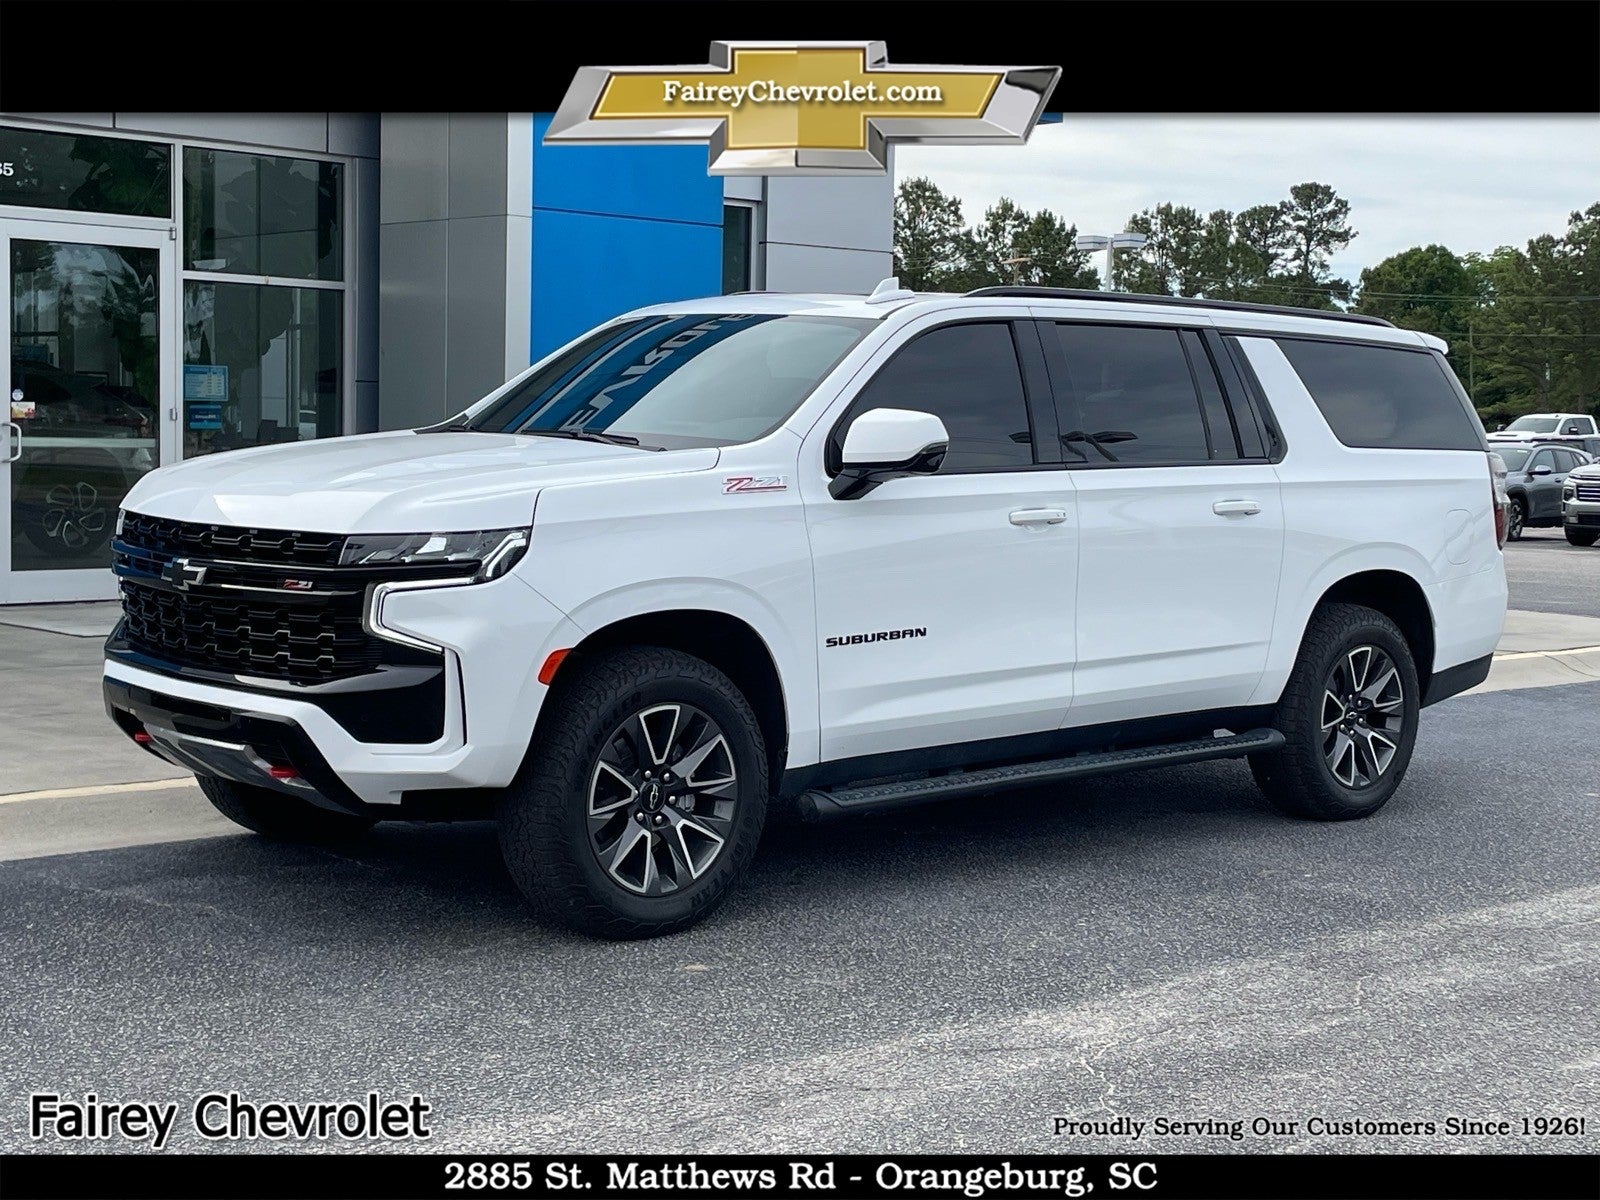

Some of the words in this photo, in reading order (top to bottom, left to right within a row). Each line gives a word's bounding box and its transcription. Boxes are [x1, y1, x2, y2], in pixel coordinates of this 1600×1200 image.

[0, 162, 14, 177] 5
[722, 476, 787, 495] Z71
[825, 627, 927, 648] SUBURBAN
